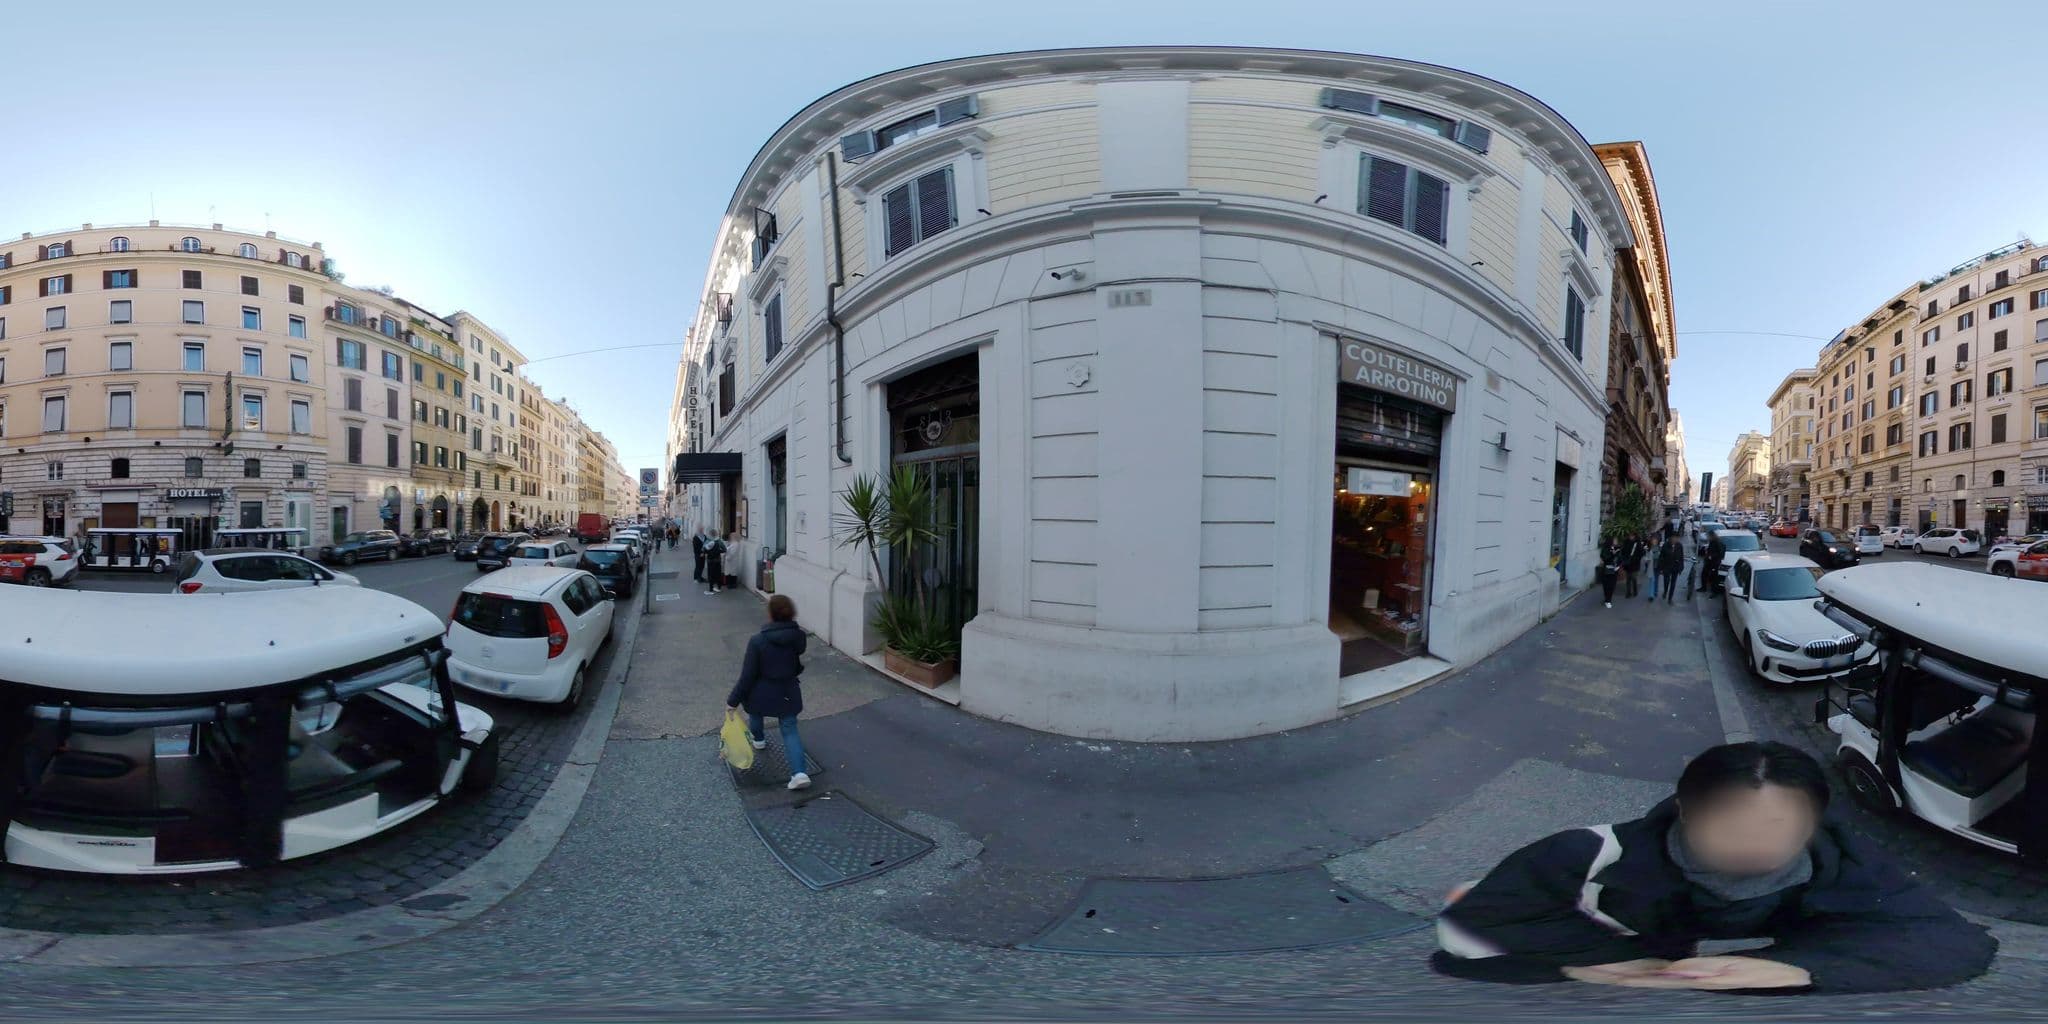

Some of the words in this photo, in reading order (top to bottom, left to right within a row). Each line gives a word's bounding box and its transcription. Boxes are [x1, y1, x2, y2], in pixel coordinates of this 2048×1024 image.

[1346, 344, 1454, 391] COLTELLERIA
[1356, 365, 1447, 405] ARROTINO
[689, 386, 698, 441] HOTEL
[170, 489, 208, 497] HOTEL
